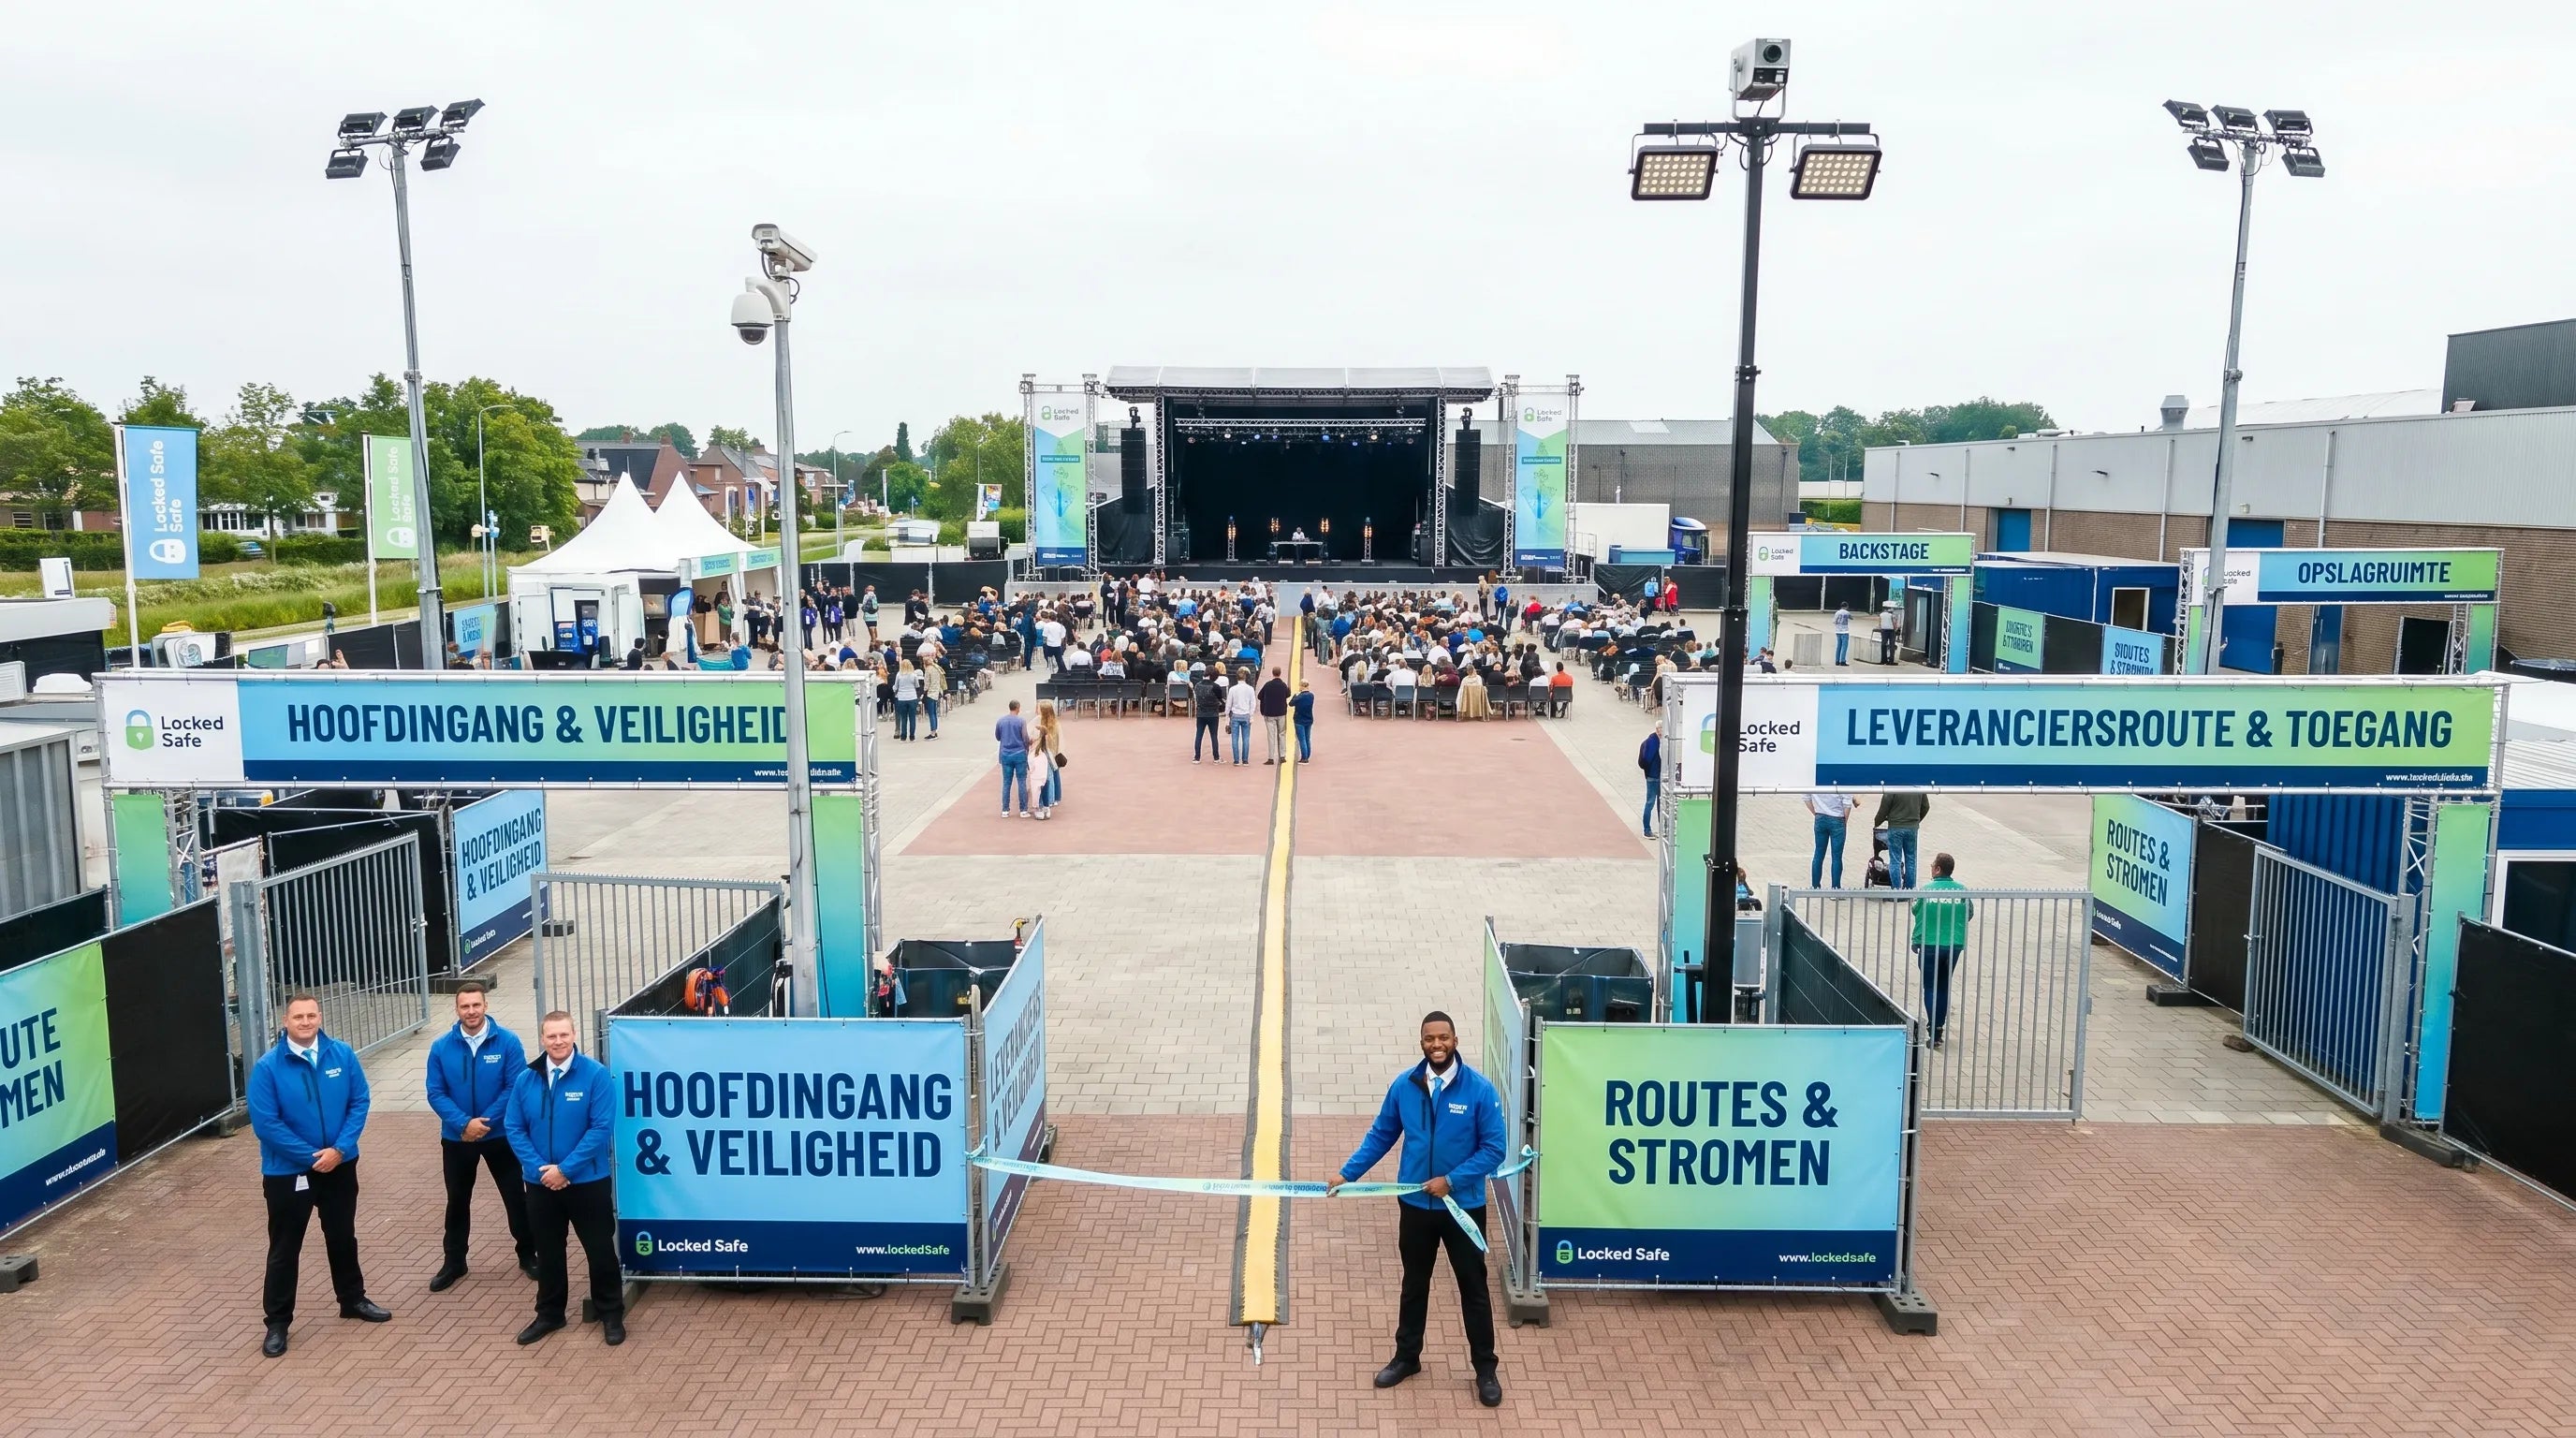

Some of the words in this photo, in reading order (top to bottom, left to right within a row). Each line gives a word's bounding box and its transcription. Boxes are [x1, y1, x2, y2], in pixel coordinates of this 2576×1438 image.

[150, 440, 165, 475] Safe
[150, 477, 168, 533] Locked
[168, 498, 183, 533] Safe
[1838, 543, 1929, 560] BACKSTAGE
[2298, 561, 2452, 584] OPSLAGRUIMTE
[161, 715, 224, 730] Locked
[162, 732, 202, 748] Safe
[287, 704, 544, 743] HOOFDINGANG
[556, 705, 584, 743] &
[594, 705, 786, 743] VEILIGHEID
[1847, 708, 2236, 747] LEVERANCIERSROUTE
[2246, 710, 2274, 748] &
[2286, 710, 2453, 748] TOEGANG
[461, 808, 542, 869] HOOFDINGANG
[2106, 818, 2157, 865] ROUTES
[2159, 841, 2171, 872] &
[467, 873, 477, 902] &
[479, 840, 542, 894] VEILIGHEID
[2106, 852, 2168, 907] STROMEN
[0, 1059, 66, 1129] MEN
[623, 1070, 952, 1121] HOOFDINGANG
[1604, 1079, 1788, 1128] ROUTES
[1802, 1080, 1839, 1129] &
[635, 1128, 673, 1177] &
[686, 1129, 942, 1179] VEILIGHEID
[1608, 1137, 1831, 1186] STROMEN
[658, 1239, 711, 1252] Locked
[714, 1239, 749, 1253] Safe
[856, 1244, 950, 1255] www.lockedSafe
[1577, 1247, 1632, 1261] Locked
[1635, 1247, 1670, 1262] Safe
[1778, 1252, 1877, 1264] www.lockedsafe
